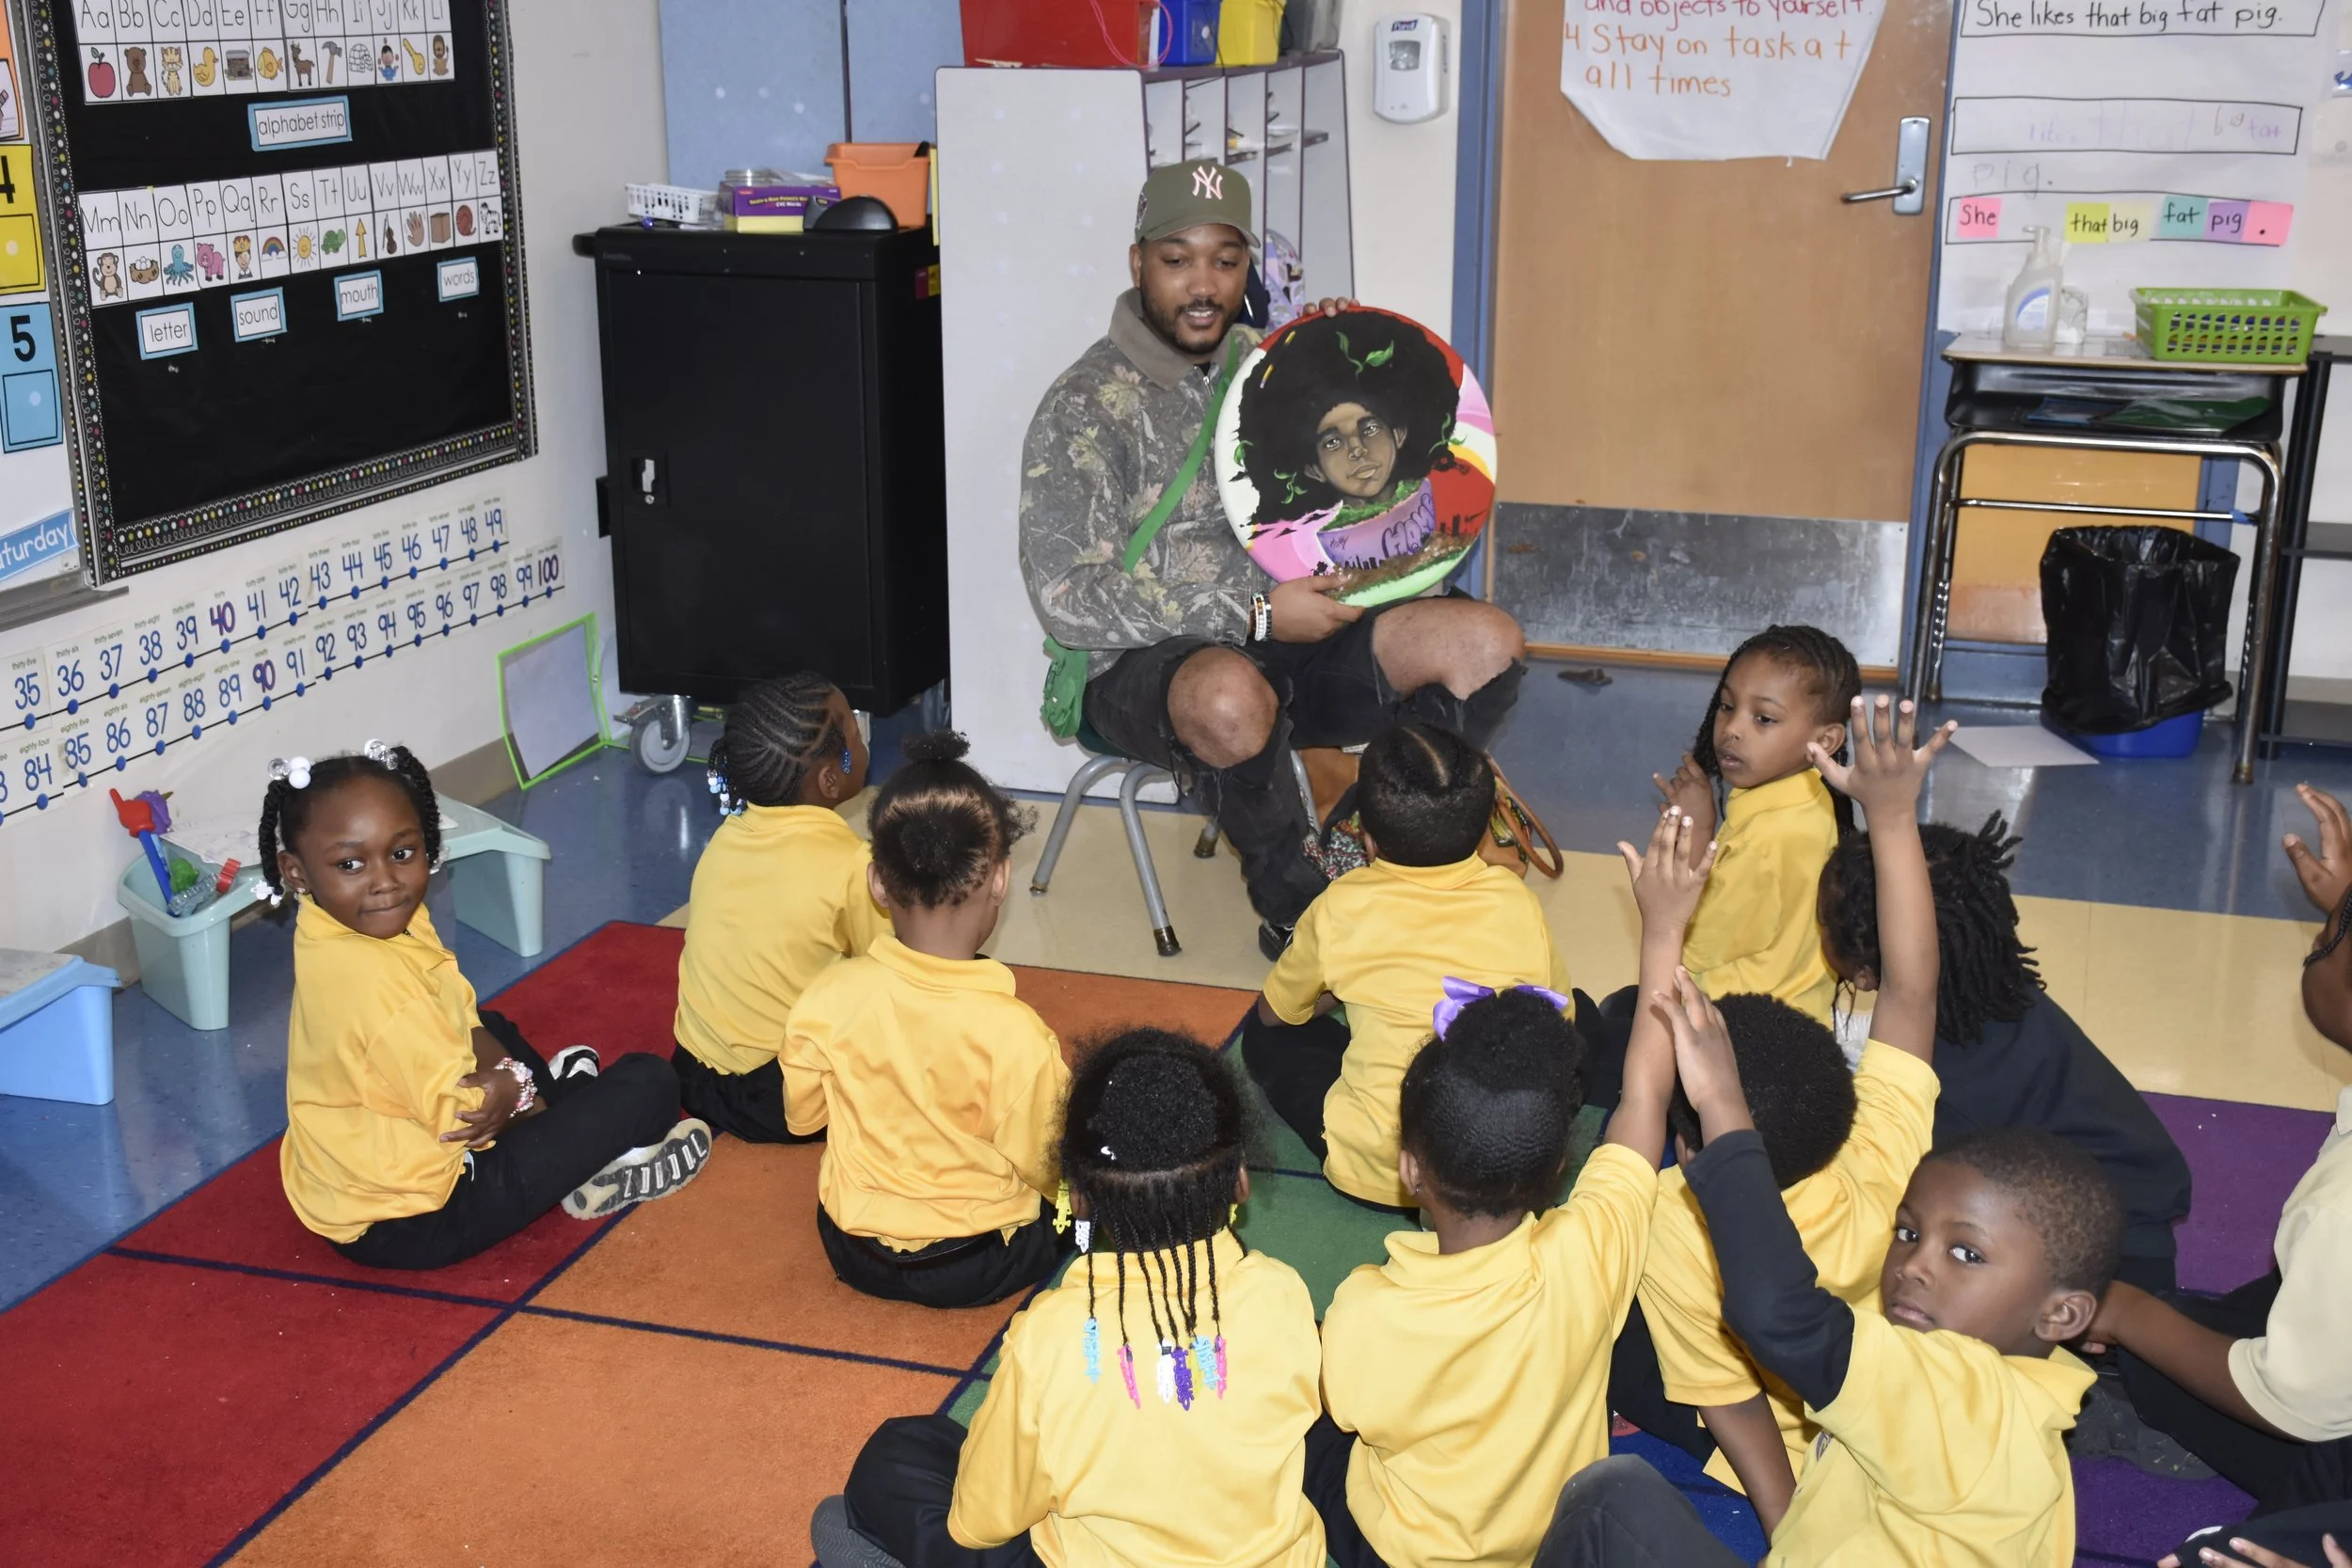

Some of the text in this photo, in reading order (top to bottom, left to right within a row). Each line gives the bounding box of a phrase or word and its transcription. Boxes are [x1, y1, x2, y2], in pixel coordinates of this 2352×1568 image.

[81, 0, 110, 28] Aa
[119, 0, 145, 28] Bb
[153, 0, 181, 28] Cc
[188, 0, 214, 27] Dd
[1976, 0, 2283, 33] She likes that big fat pig.
[1564, 24, 1581, 51] 4
[1593, 24, 1664, 62] Stay
[1677, 39, 1708, 55] on
[1725, 26, 1796, 61] task
[1585, 62, 1731, 97] all times
[257, 108, 346, 138] alphabet strip
[80, 159, 497, 234] Mm Nn Oo Pp Qq Rr Ss Tt Uu Vv Ww Xx Yy Zz
[1192, 166, 1223, 200] NY
[1960, 203, 1997, 227] She
[2070, 213, 2108, 234] that
[2112, 213, 2139, 236] big
[2164, 202, 2200, 224] fat
[2211, 212, 2243, 233] pig
[340, 282, 378, 304] mouth
[442, 268, 476, 287] words
[149, 320, 189, 343] letter
[238, 303, 279, 326] sound
[10, 315, 36, 362] 5
[15, 508, 503, 710] 35 36 37 38 39 40 41 42 43 44 45 46 47 48 49
[24, 752, 53, 792] 84
[65, 732, 91, 769] 85
[105, 717, 131, 753] 86
[146, 702, 168, 737] 87
[183, 688, 205, 722] 88
[219, 673, 242, 707] 89
[253, 659, 276, 692] 90
[286, 648, 306, 678] 91
[315, 632, 337, 664] 92
[347, 622, 367, 652] 93
[378, 610, 396, 641] 94
[407, 601, 426, 630] 95
[436, 591, 453, 620] 96
[463, 582, 480, 610] 97
[490, 573, 507, 600] 98
[516, 564, 533, 592] 99
[538, 554, 559, 587] 100
